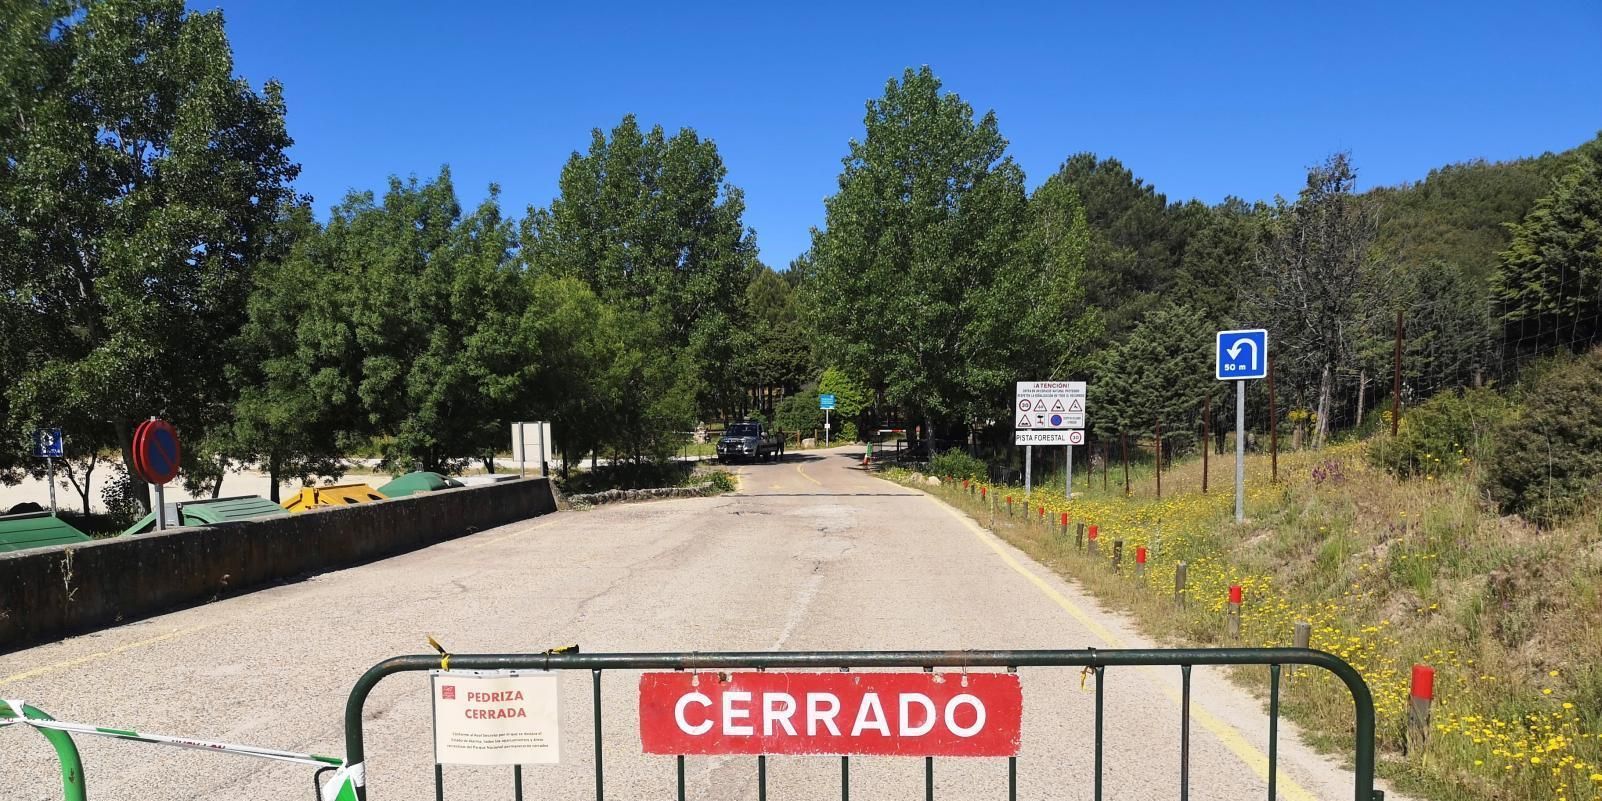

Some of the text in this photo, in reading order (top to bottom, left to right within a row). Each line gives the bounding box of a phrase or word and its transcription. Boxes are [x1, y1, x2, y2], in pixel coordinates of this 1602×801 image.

[1224, 363, 1236, 371] 50
[467, 691, 524, 702] PEDRIZA
[465, 708, 527, 719] CERRADA
[674, 692, 987, 737] CERRADO
